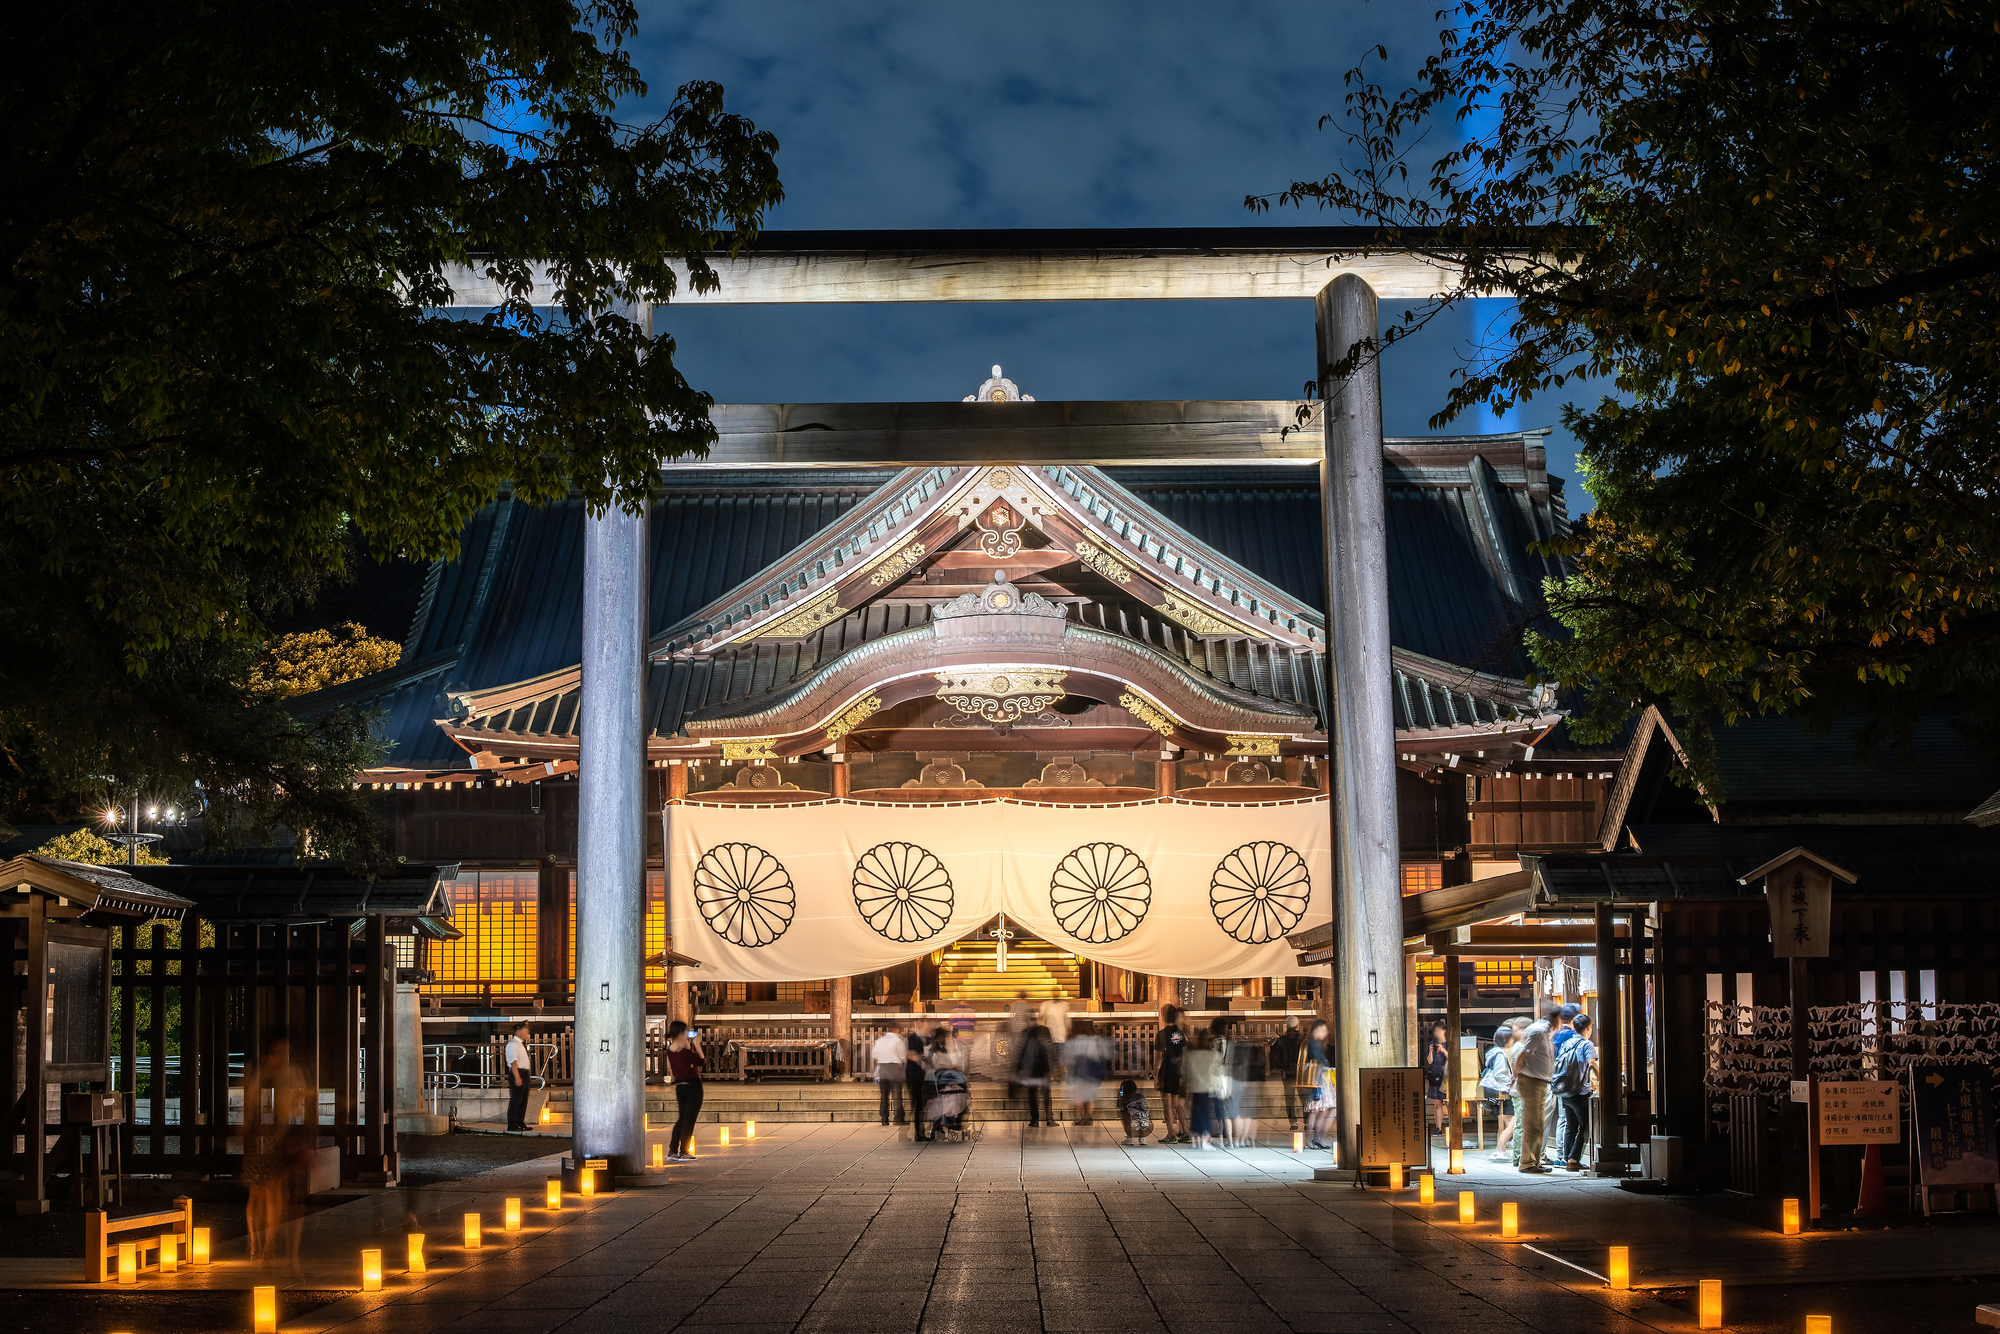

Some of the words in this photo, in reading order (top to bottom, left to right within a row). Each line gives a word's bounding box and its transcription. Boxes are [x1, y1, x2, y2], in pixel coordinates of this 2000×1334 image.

[1412, 1091, 1420, 1142] 報道関係者各位
[1943, 1103, 1962, 1160] 七十年展
[1957, 1079, 1976, 1151] 大東亜戦争
[1929, 1126, 1946, 1170] 最終章
